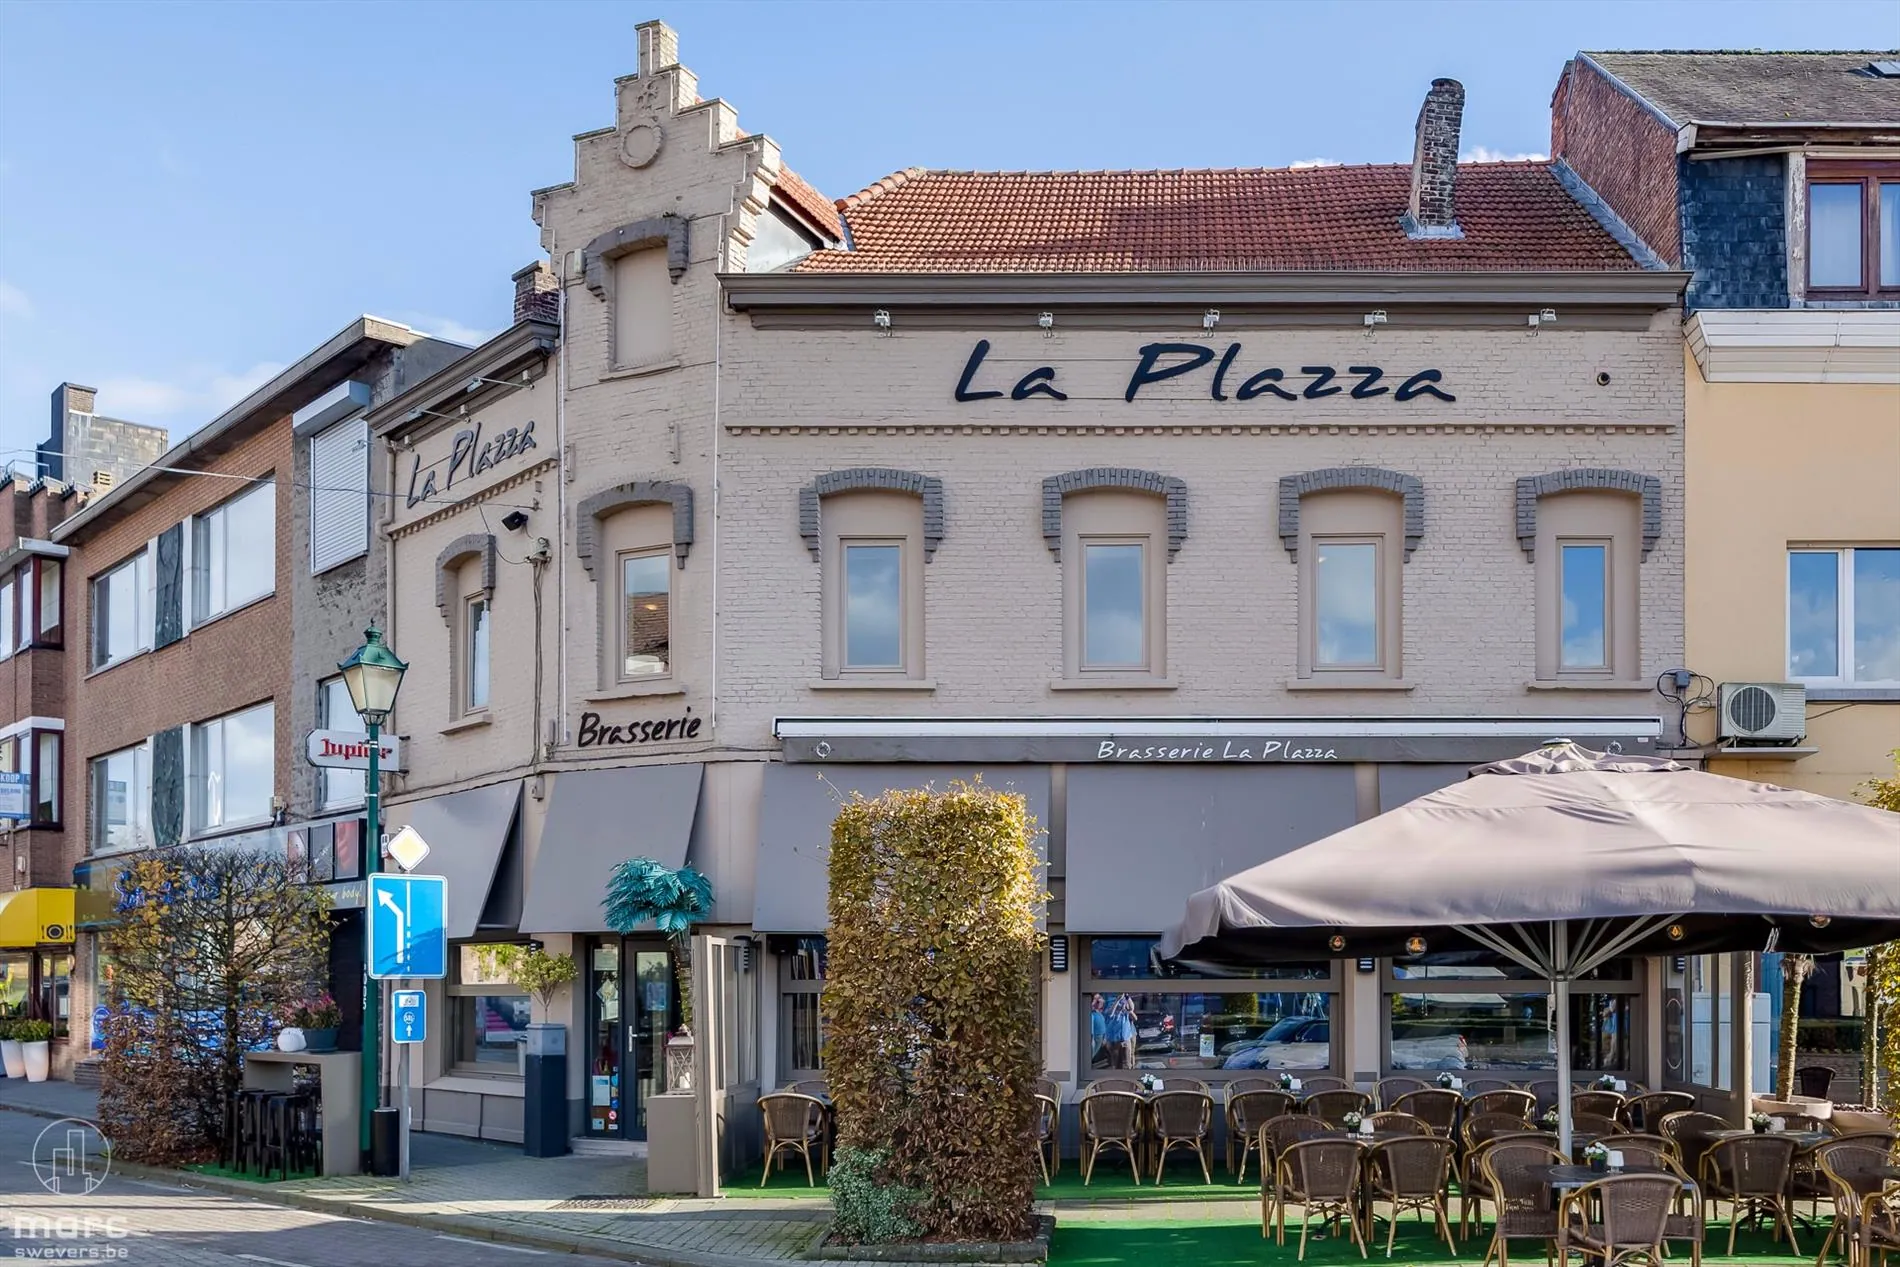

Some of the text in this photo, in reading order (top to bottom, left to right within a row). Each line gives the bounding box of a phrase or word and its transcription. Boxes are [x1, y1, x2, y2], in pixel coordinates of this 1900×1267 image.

[955, 339, 1457, 403] La Plazza
[407, 420, 536, 509] La Plazza
[578, 706, 701, 747] Brasserie
[1097, 740, 1338, 760] Brasserie La Plazza
